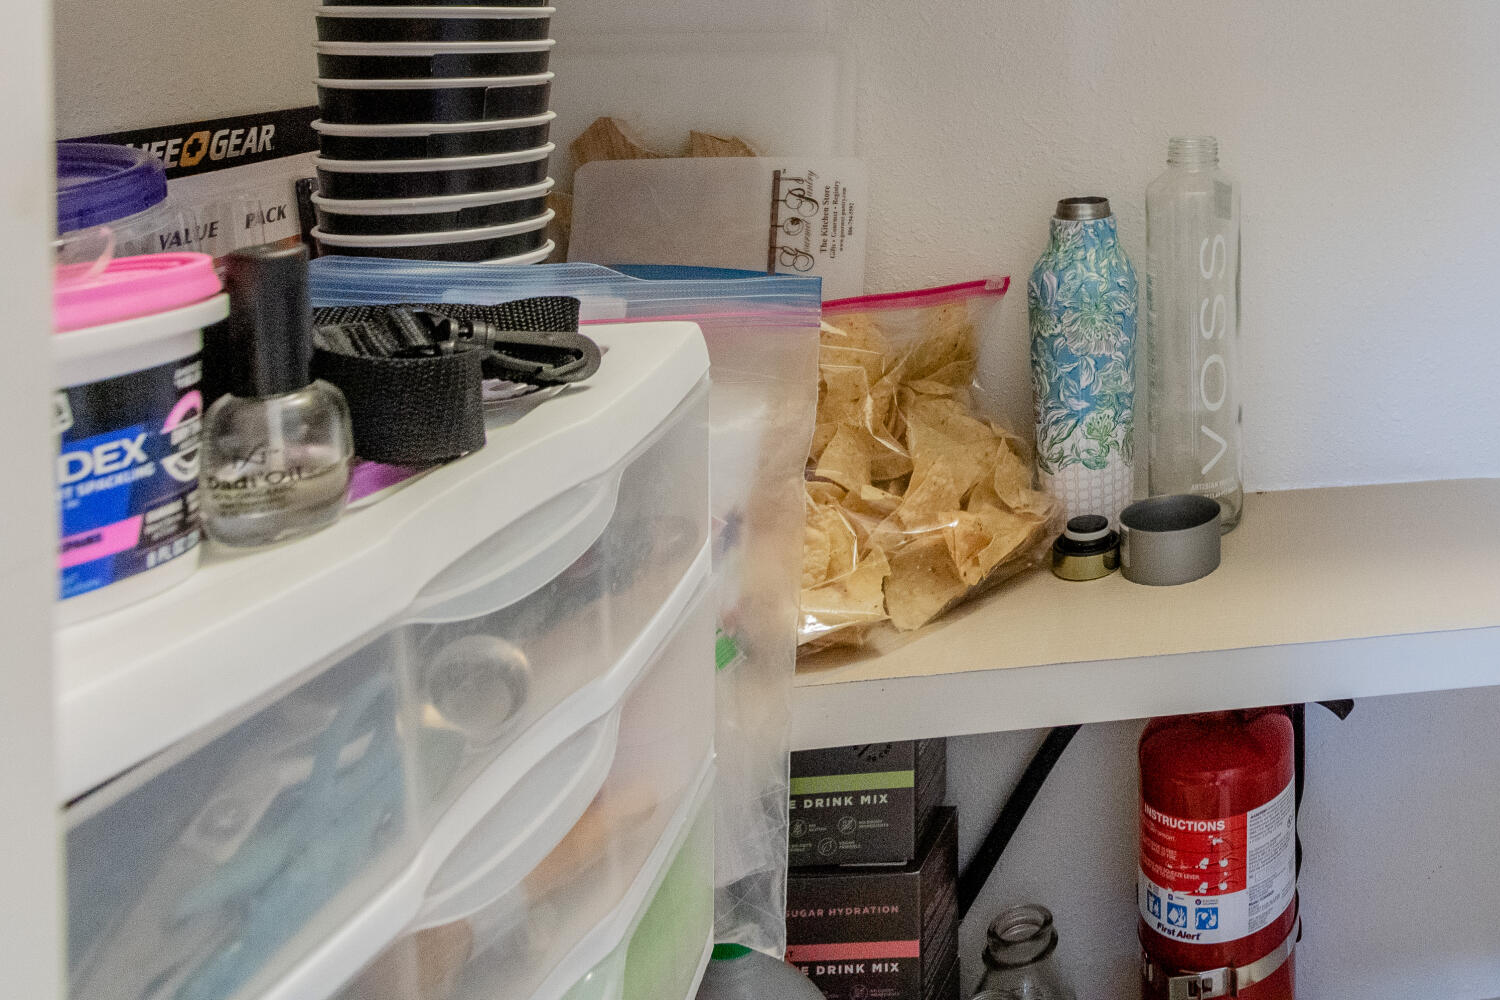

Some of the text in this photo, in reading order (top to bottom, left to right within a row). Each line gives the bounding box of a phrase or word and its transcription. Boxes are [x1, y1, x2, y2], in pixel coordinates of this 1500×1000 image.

[208, 124, 276, 161] GEAR
[159, 220, 220, 250] VALUE
[245, 204, 289, 229] PACK
[820, 185, 831, 254] The Kitchen Store
[1200, 234, 1228, 476] VOSS
[803, 796, 853, 809] DRINK
[860, 794, 889, 805] MIX
[1144, 802, 1226, 832] INSTRUCTIONS
[786, 905, 900, 919] SUGAR HYDRATION
[1157, 921, 1201, 941] First Alert
[816, 963, 865, 976] DRINK
[871, 962, 901, 973] MIX
